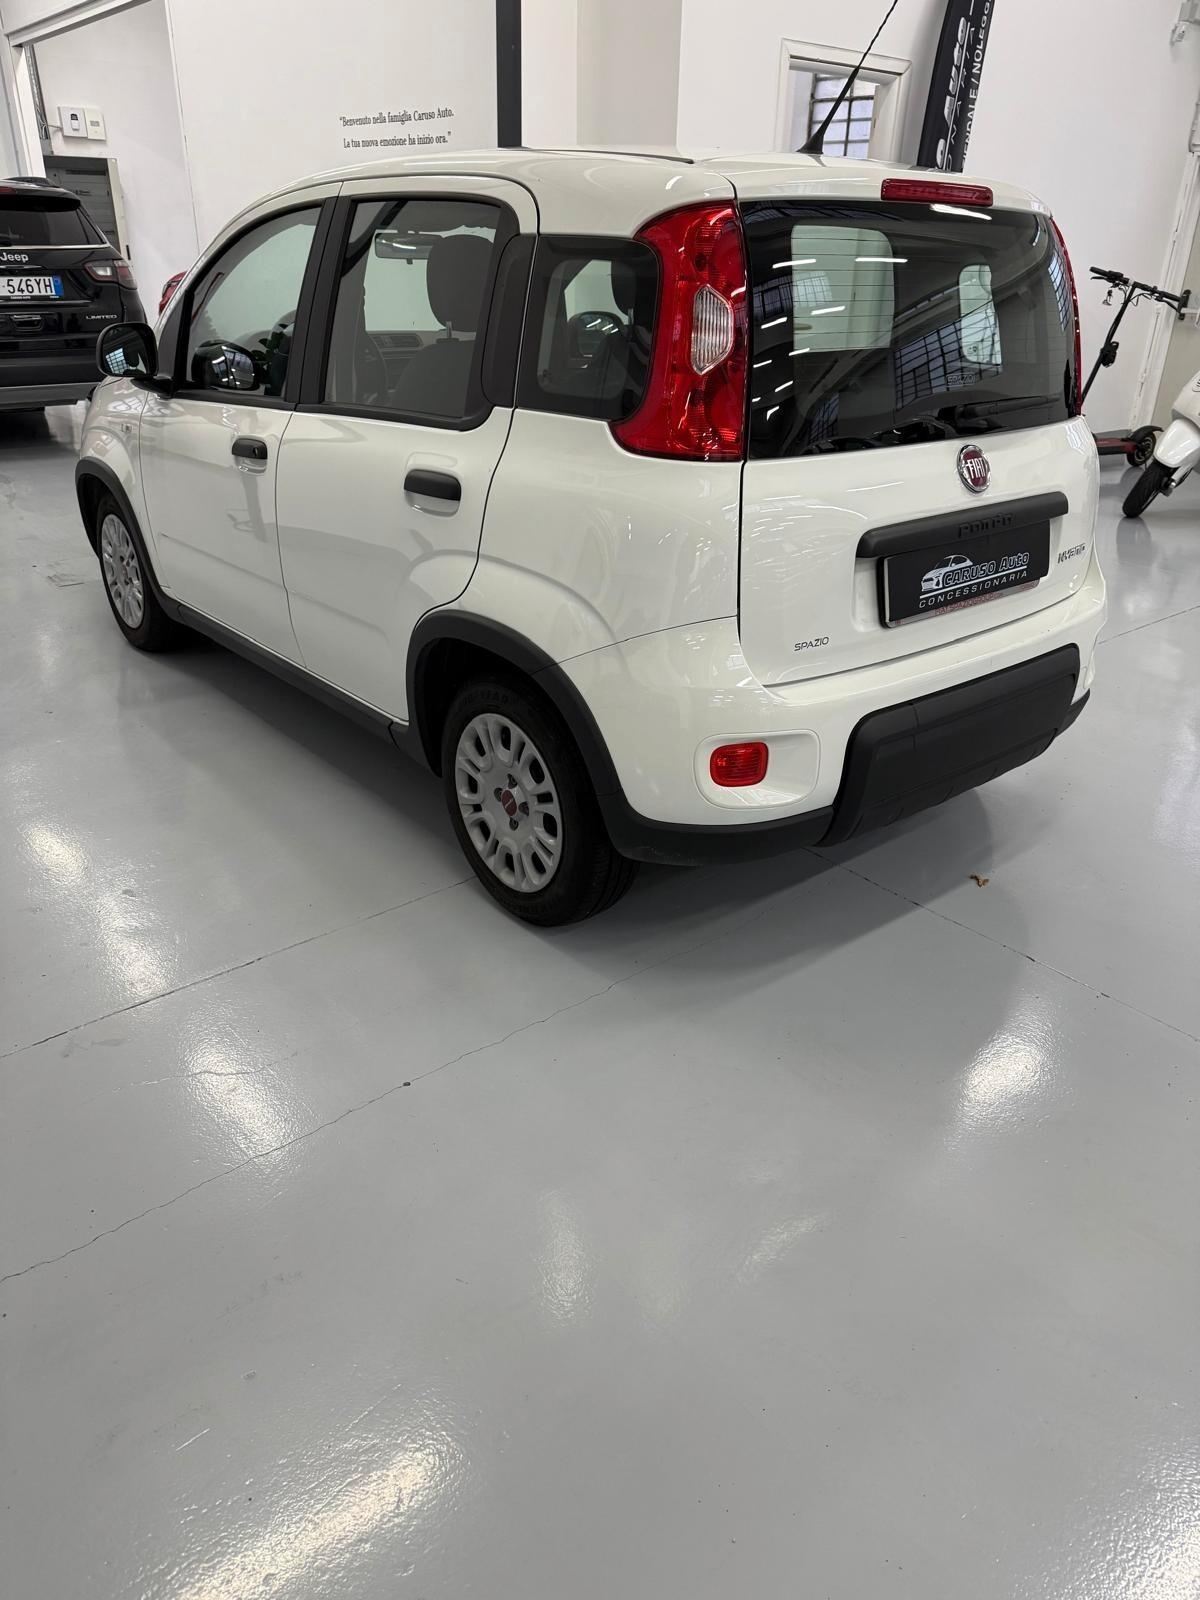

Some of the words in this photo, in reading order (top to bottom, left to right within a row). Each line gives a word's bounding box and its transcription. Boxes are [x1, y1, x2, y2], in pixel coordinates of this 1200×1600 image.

[971, 0, 991, 74] NOLEGG
[372, 111, 387, 124] nella
[388, 109, 412, 125] famiglia
[413, 110, 436, 121] Caruso
[437, 107, 454, 119] Auto.
[343, 138, 351, 148] La
[351, 138, 361, 148] tua
[361, 139, 379, 148] nuova
[379, 136, 407, 147] emozione
[408, 134, 416, 146] ha
[417, 133, 434, 145] inizio
[0, 252, 28, 262] Jeep
[6, 278, 53, 294] 546YH
[965, 457, 986, 479] FIAT
[943, 560, 997, 587] CARUSO
[918, 570, 1028, 609] CONCESSIONARIA
[793, 636, 830, 652] SPAZIO
